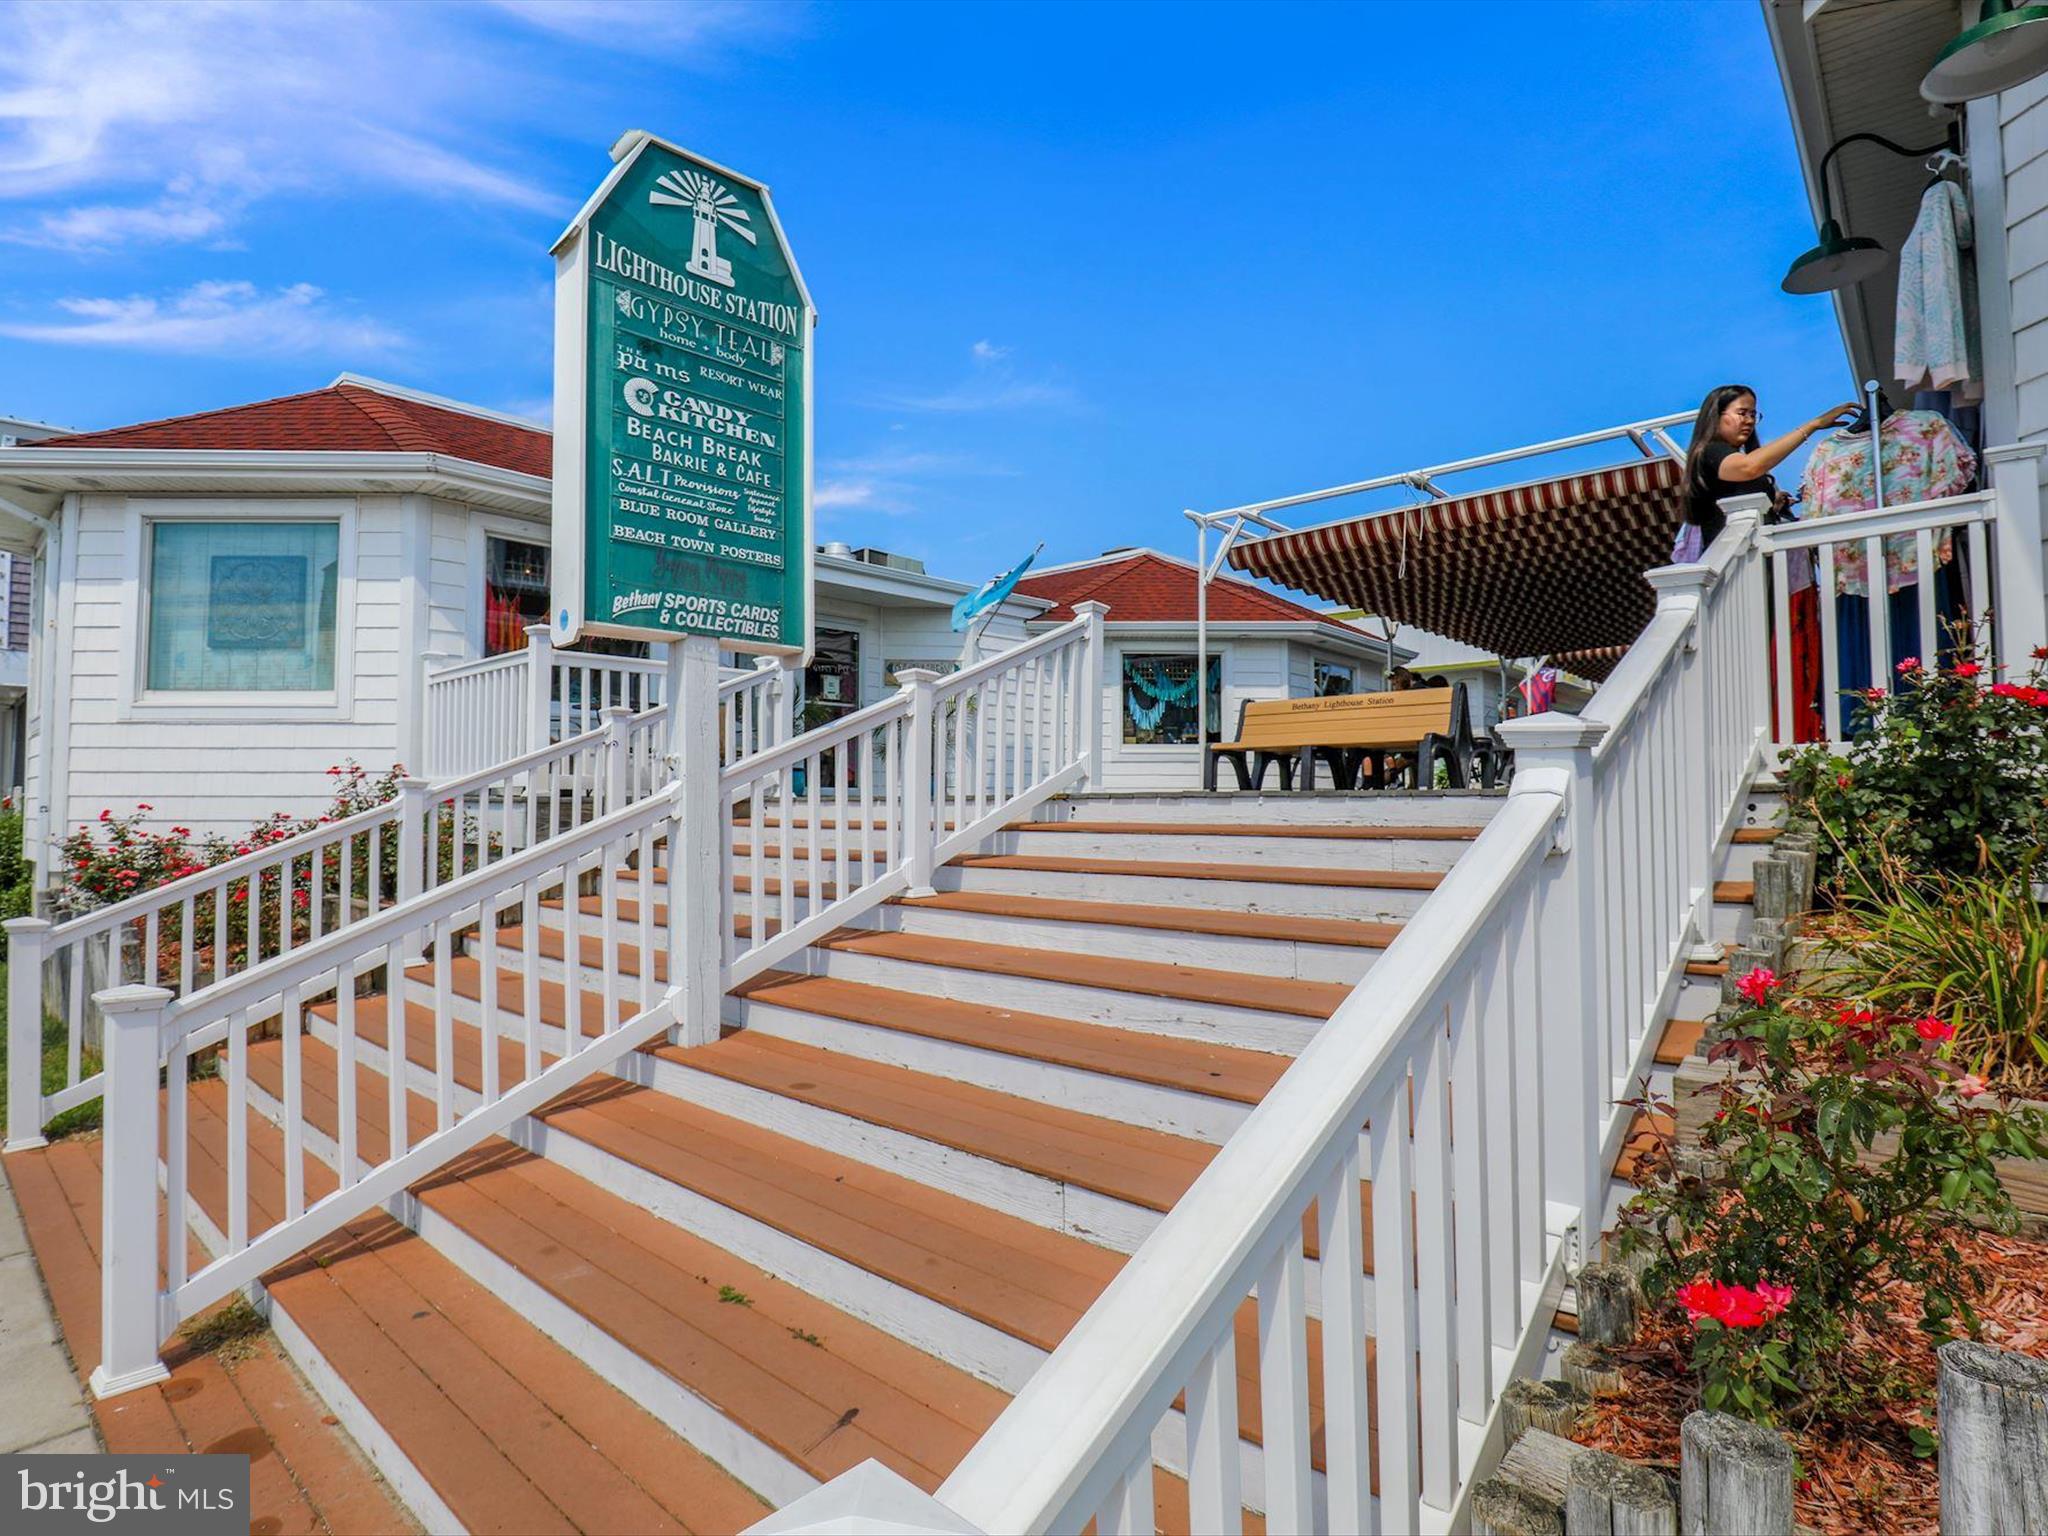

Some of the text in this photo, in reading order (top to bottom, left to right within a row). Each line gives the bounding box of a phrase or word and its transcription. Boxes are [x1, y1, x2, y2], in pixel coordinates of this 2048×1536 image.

[596, 231, 797, 336] LIGHTHOUSE STATION
[630, 296, 772, 364] GYPSY TEAL
[660, 327, 696, 348] home
[716, 345, 746, 367] body
[616, 344, 642, 356] THE
[699, 366, 783, 400] RESORT WEAR
[657, 403, 776, 448] KITCHEN
[663, 390, 752, 426] CANDY
[627, 416, 761, 468] BEACH BREAK
[652, 443, 771, 488] BAKRIE & CAFE
[618, 482, 735, 516] Coastal General Store
[674, 475, 741, 499] Provisions
[619, 498, 776, 540] BLUE ROOM GALLERY
[697, 528, 706, 538] &
[613, 525, 781, 566] BEACH TOWN POSTERS
[611, 589, 780, 623] Bethany SPORTS CARDS
[660, 609, 780, 639] & COLLECTIBLES
[1292, 697, 1394, 711] Bethany Lighthouse Station
